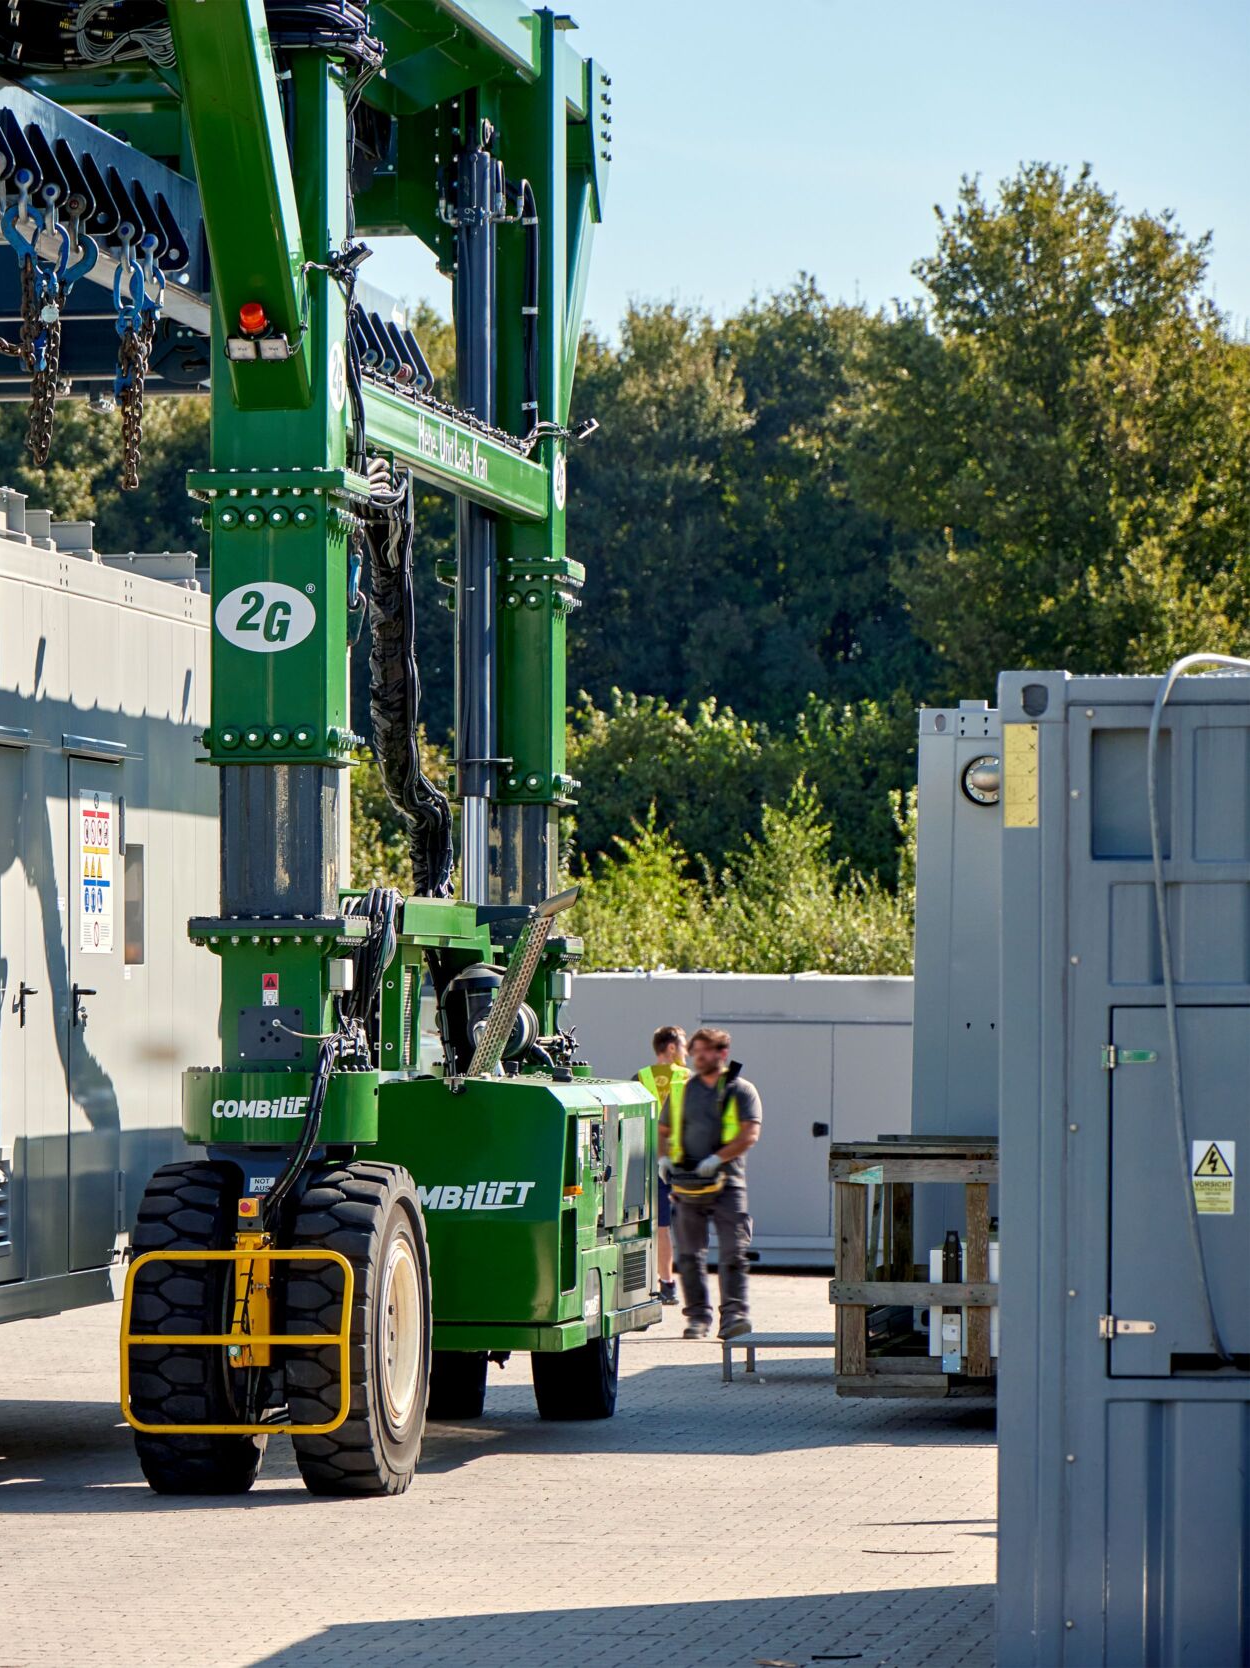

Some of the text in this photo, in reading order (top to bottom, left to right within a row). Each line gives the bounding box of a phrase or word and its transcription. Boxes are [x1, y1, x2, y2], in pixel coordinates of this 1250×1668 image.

[472, 438, 488, 481] Kran
[236, 590, 292, 643] 2G
[212, 1096, 310, 1118] COMBiLiF
